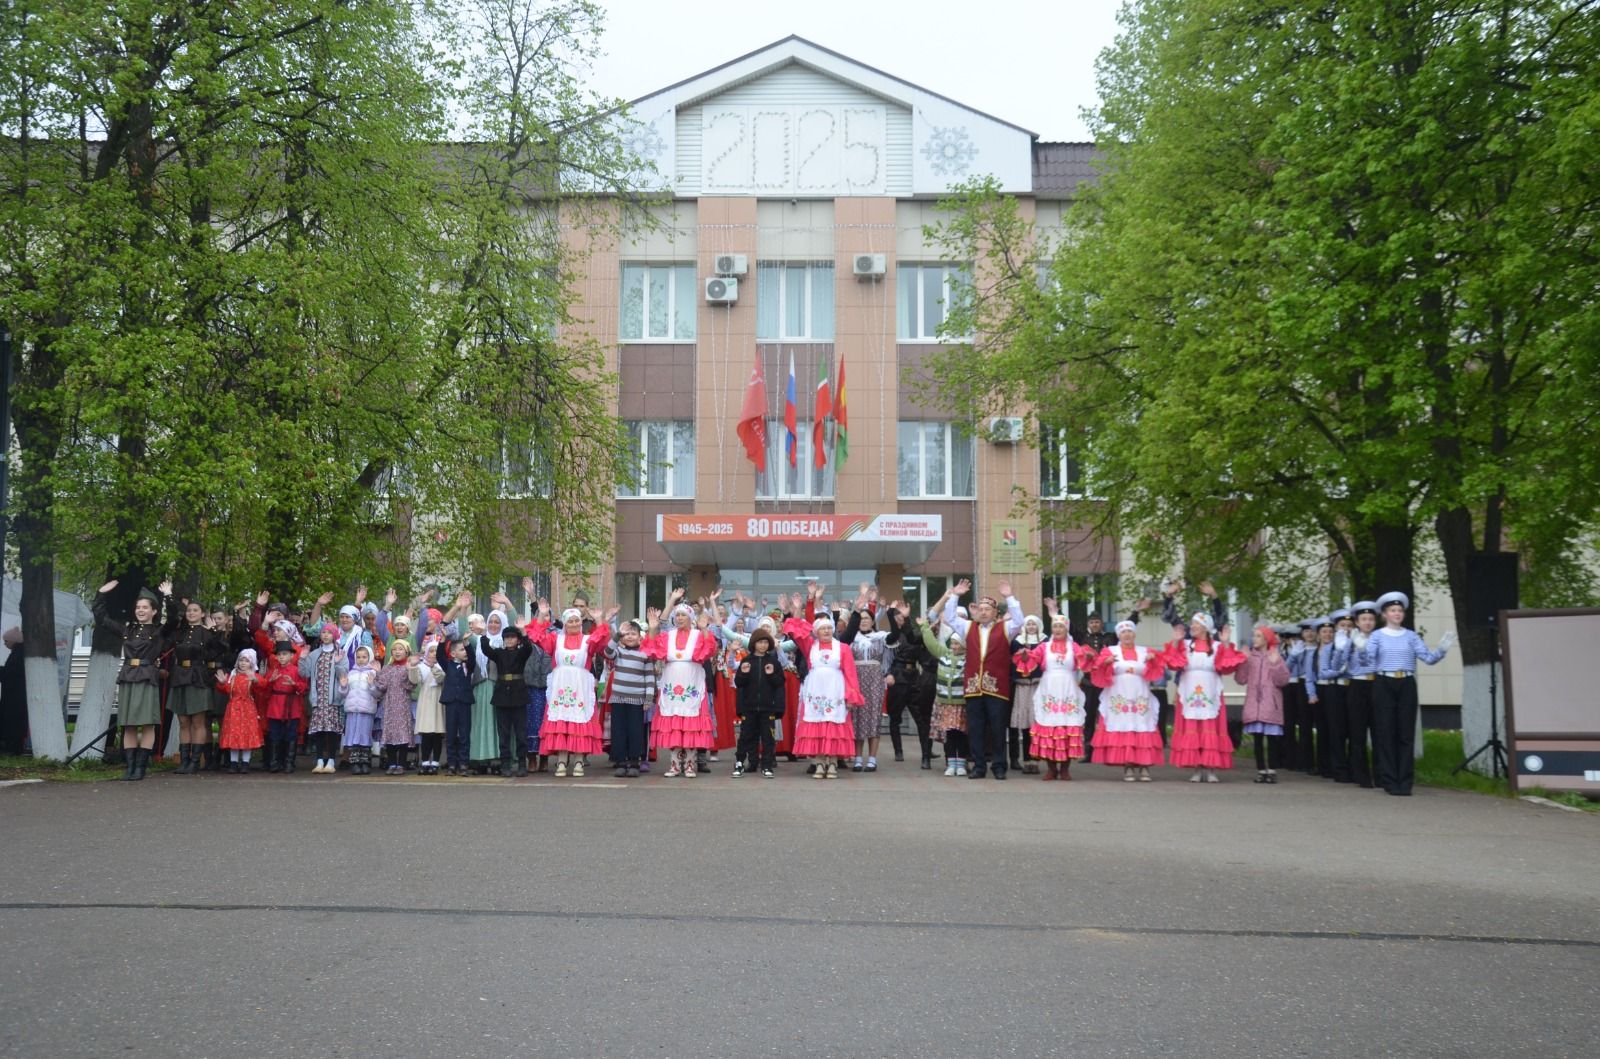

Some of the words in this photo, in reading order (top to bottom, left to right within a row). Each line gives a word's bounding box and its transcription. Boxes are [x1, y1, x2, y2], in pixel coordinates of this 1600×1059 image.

[708, 109, 879, 189] 2025
[747, 518, 769, 537] 80
[772, 520, 833, 536] ПОБЕДА!
